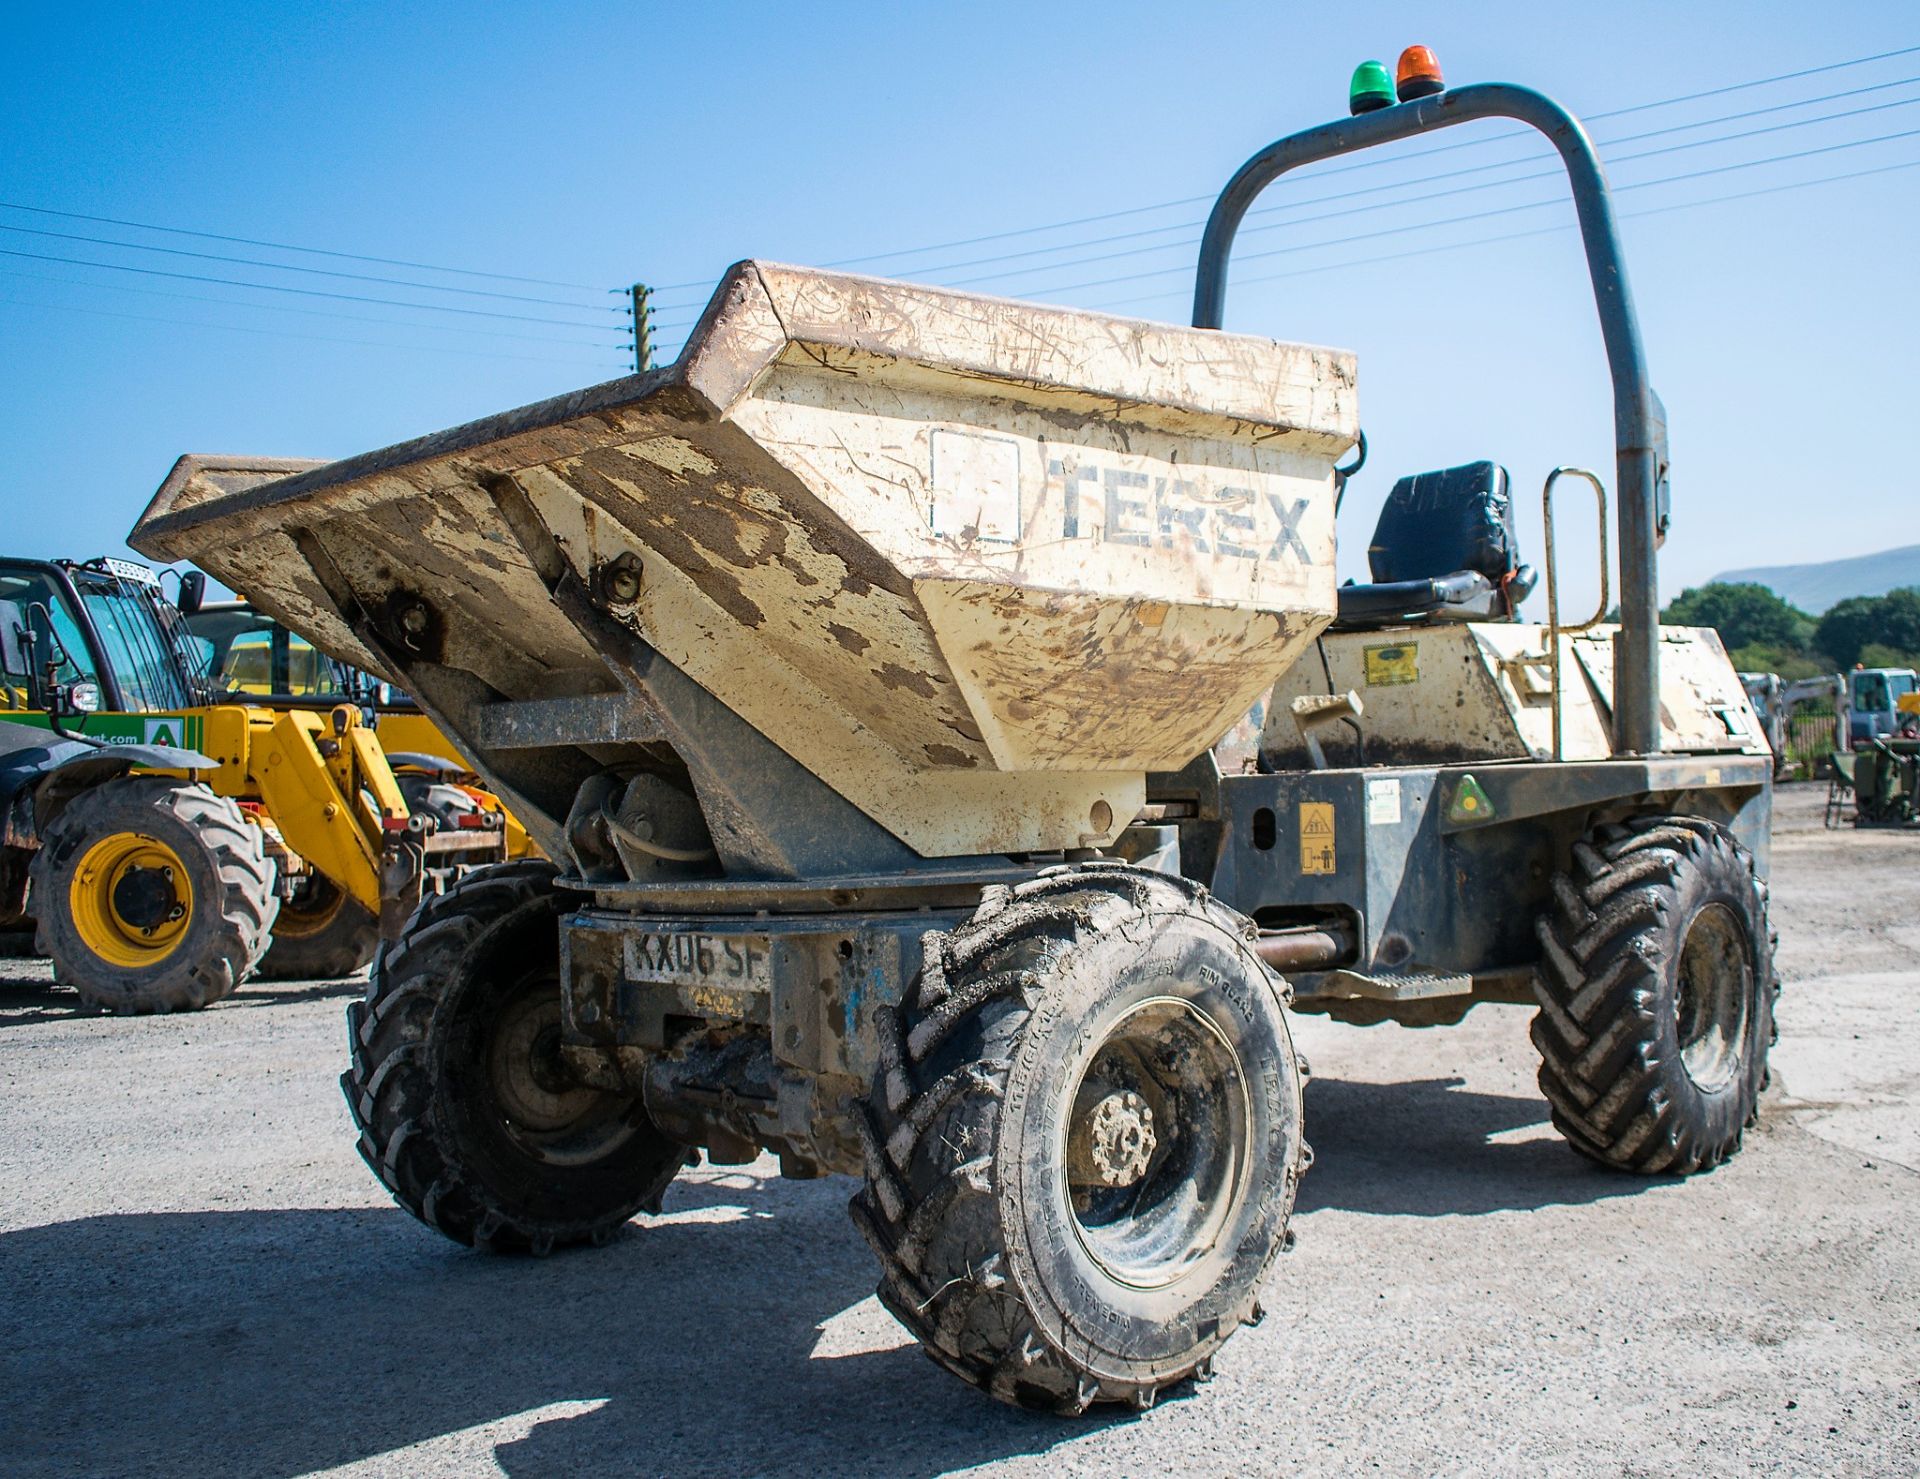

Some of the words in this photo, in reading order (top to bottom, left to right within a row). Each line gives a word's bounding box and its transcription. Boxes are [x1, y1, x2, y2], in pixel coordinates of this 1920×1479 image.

[1048, 459, 1313, 565] TEREX
[636, 934, 715, 977] KX06
[1198, 965, 1220, 986] RIM
